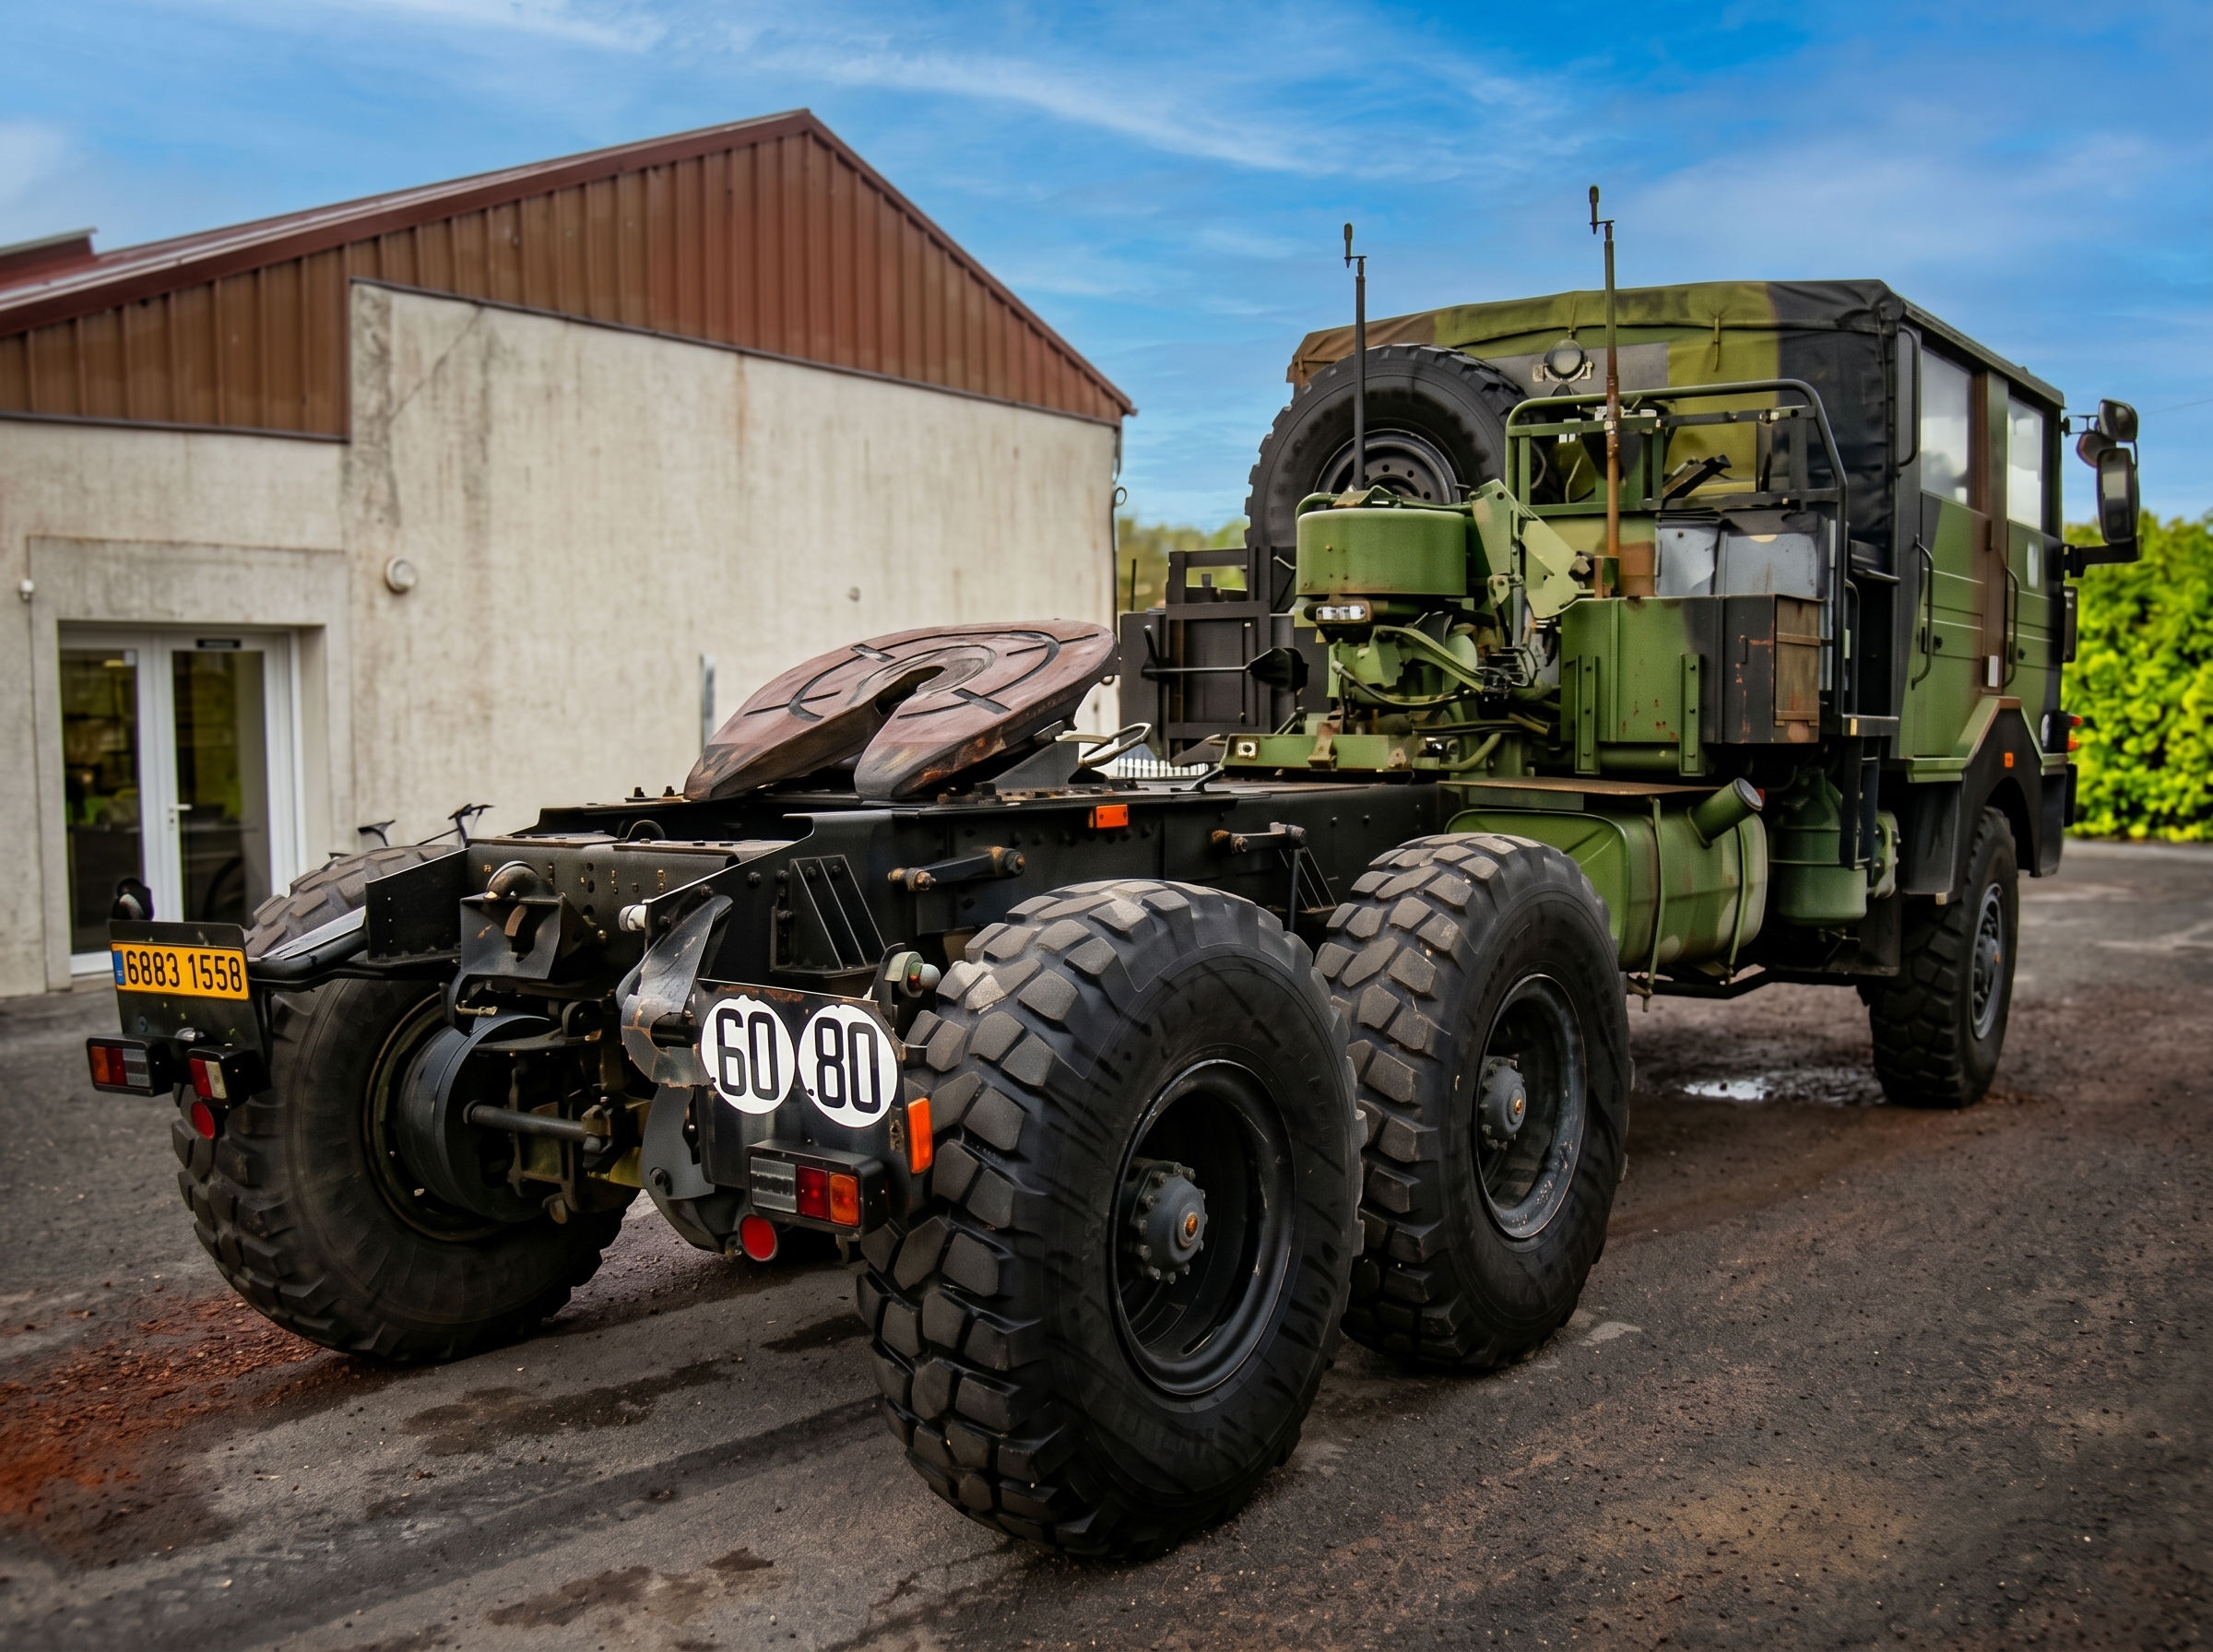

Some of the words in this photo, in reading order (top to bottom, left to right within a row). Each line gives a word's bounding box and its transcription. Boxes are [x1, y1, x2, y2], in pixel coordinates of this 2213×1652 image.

[126, 950, 180, 987] 6883
[188, 954, 242, 992] 1558
[716, 1008, 779, 1101] 60
[815, 1017, 881, 1114] 80
